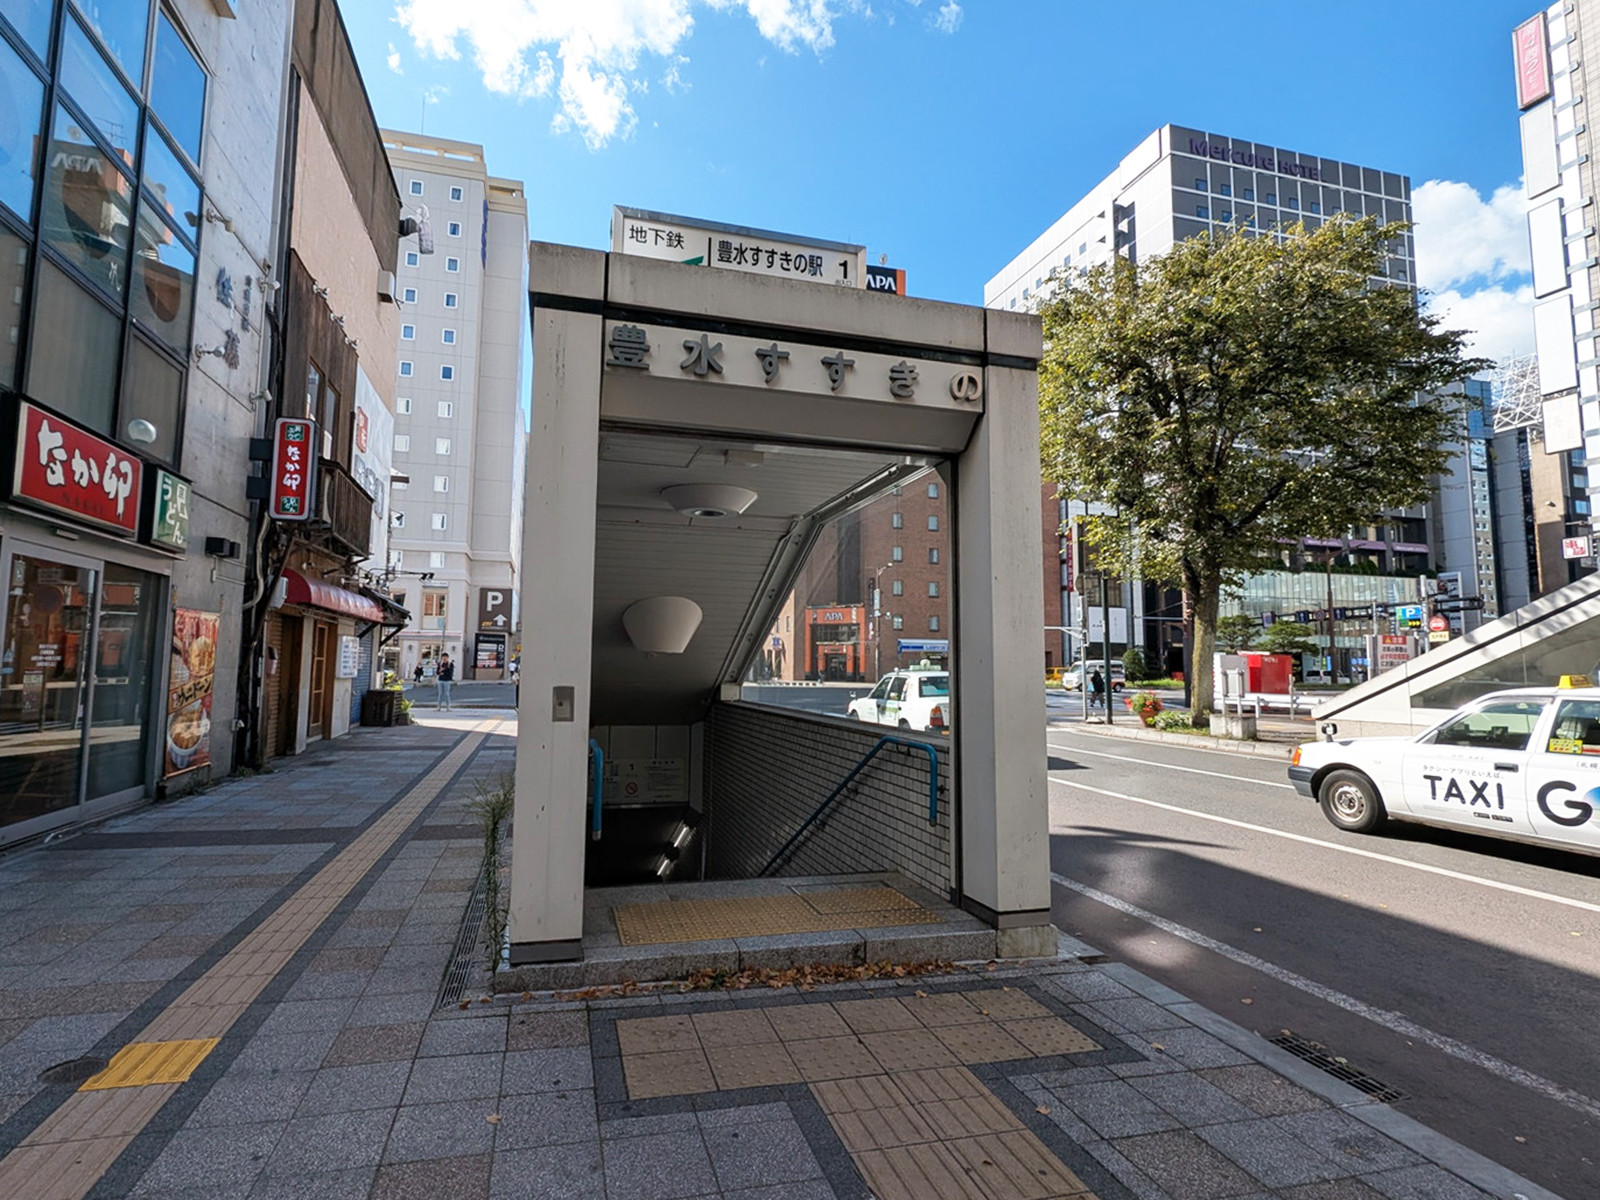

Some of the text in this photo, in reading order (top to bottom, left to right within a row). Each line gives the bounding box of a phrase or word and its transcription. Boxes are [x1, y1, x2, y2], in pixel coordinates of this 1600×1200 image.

[1189, 138, 1275, 171] Mercure
[629, 224, 685, 250] 地下鉄
[716, 239, 848, 279] 豊水すすきの駅 1
[866, 274, 896, 291] APA
[606, 323, 983, 402] 豊水すすきの
[38, 418, 134, 522] なか卯
[282, 445, 301, 491] なか卯
[162, 476, 184, 545] うどん
[486, 591, 503, 612] P
[824, 612, 843, 621] APA
[1405, 608, 1416, 619] P
[1423, 774, 1504, 810] TAXI
